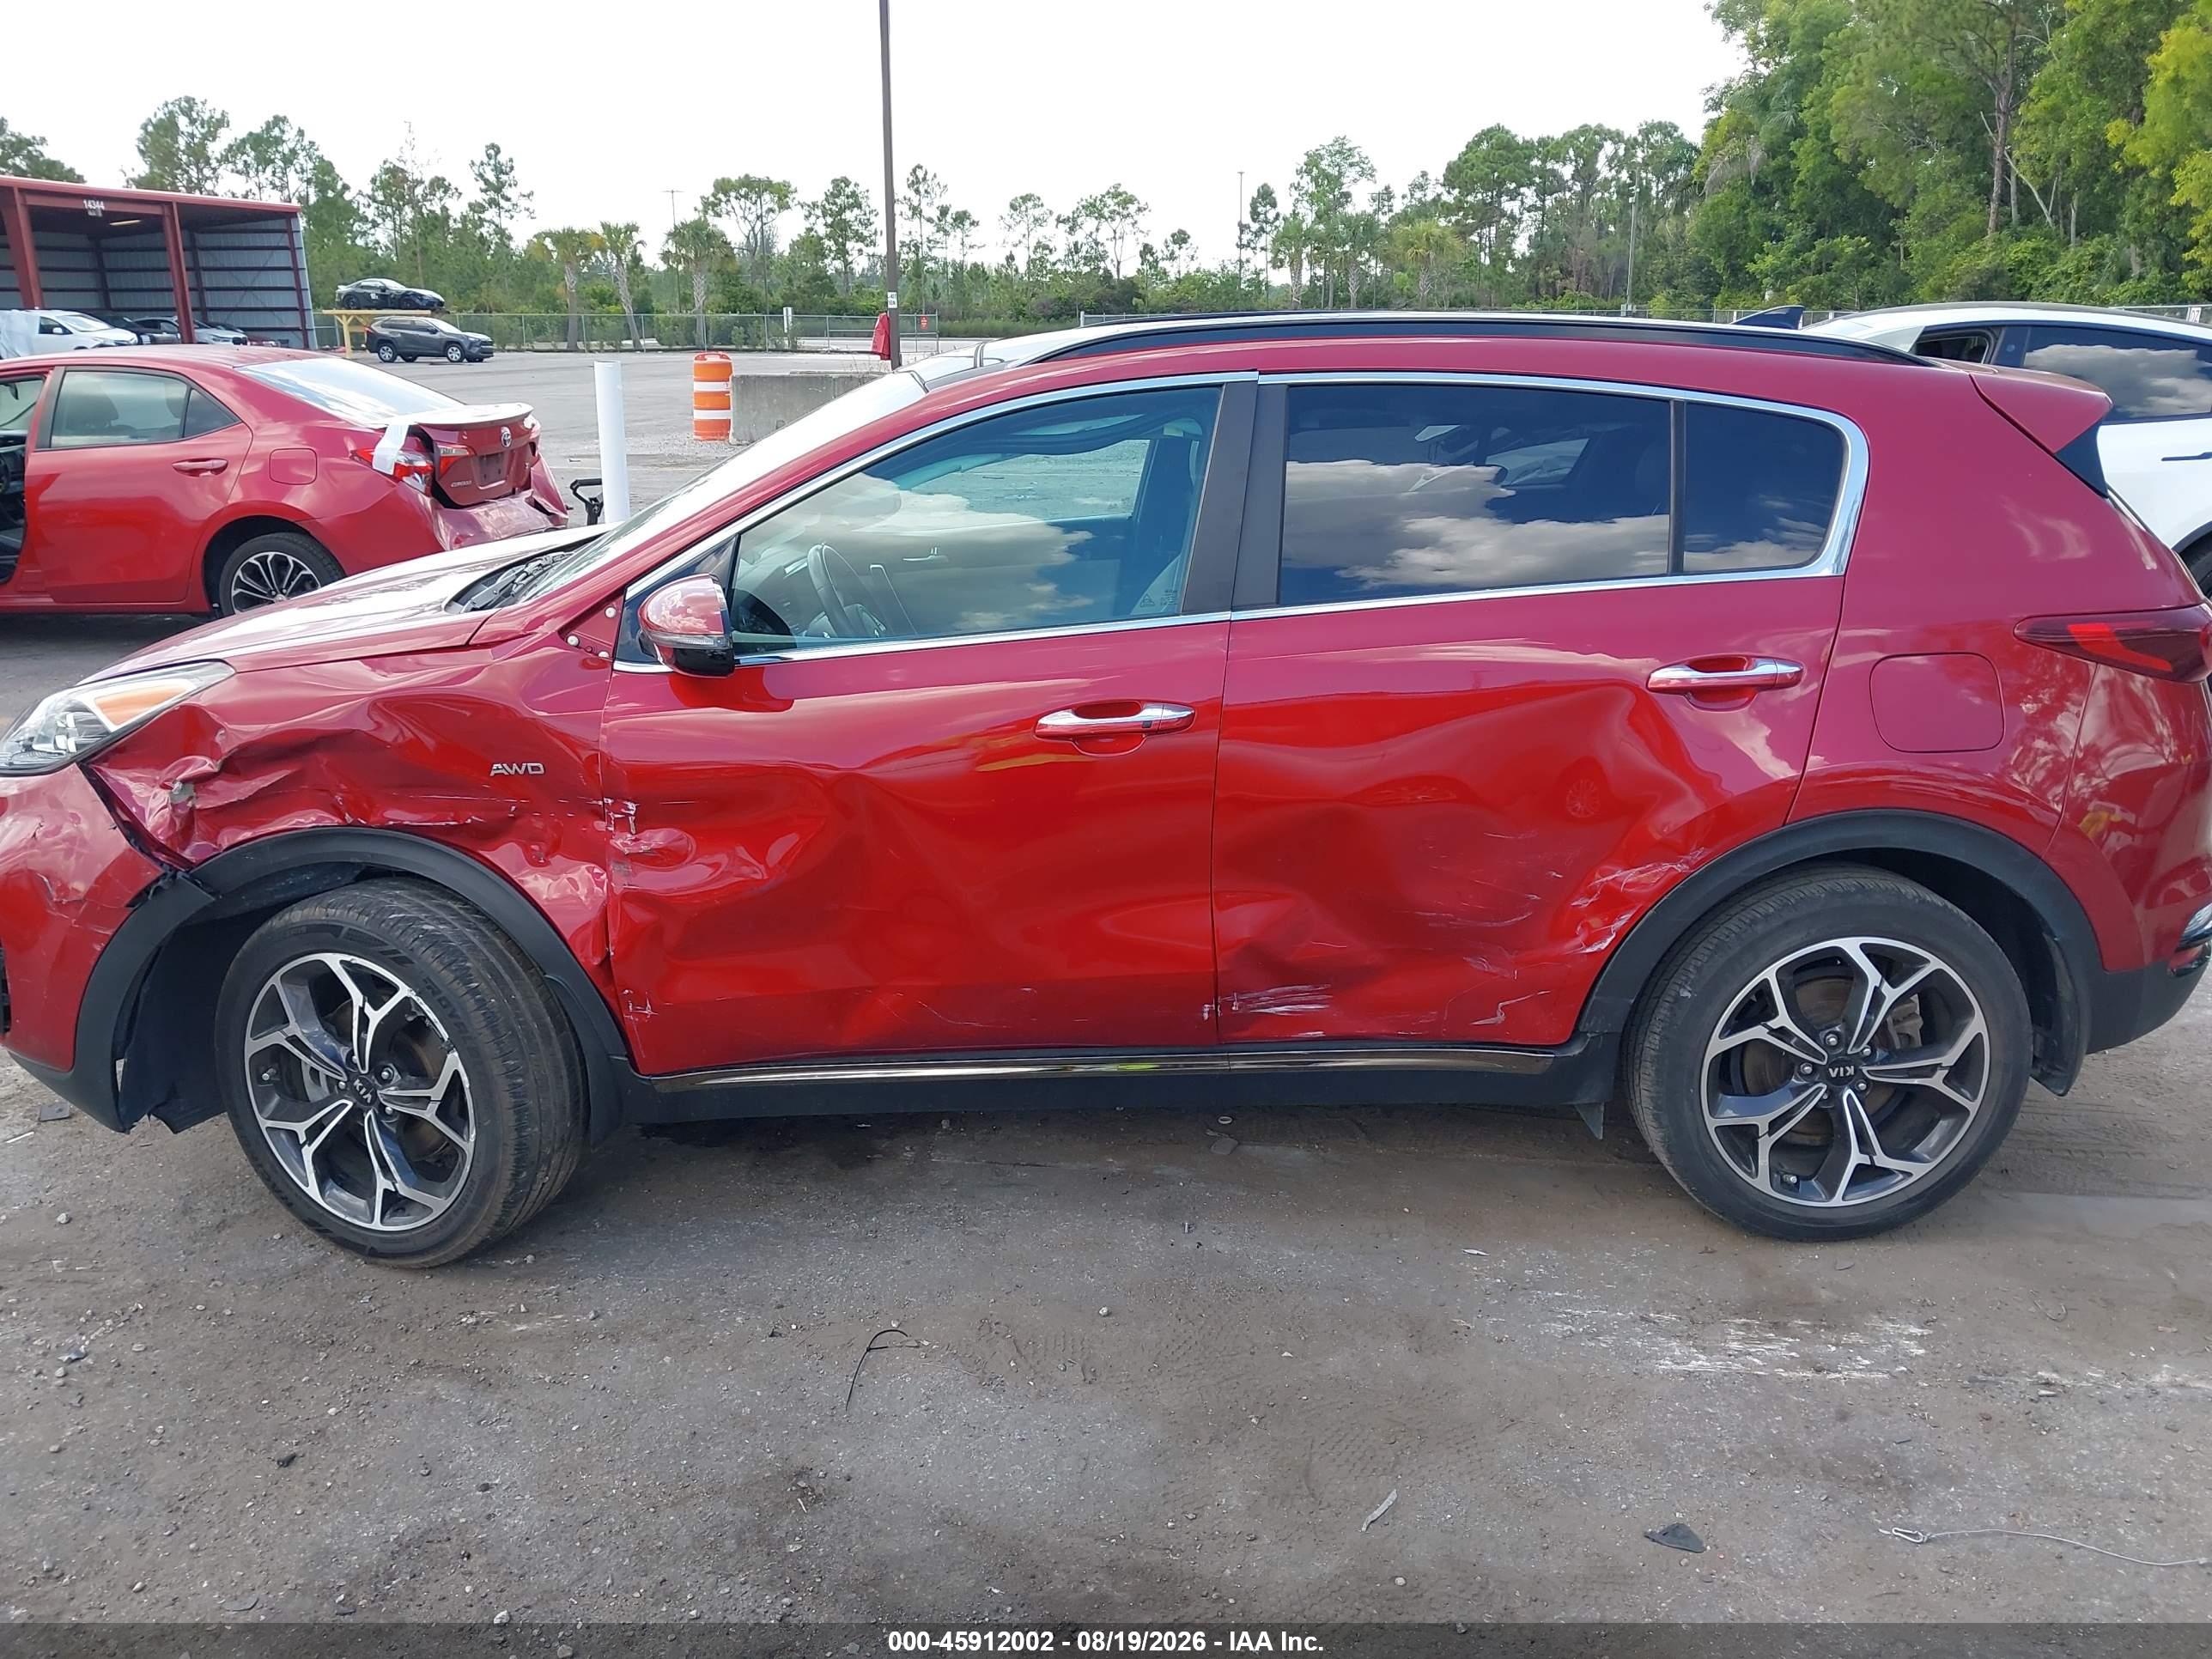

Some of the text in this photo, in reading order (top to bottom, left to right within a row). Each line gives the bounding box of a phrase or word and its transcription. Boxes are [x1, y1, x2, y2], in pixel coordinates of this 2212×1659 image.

[489, 763, 544, 776] AWD
[1829, 1066, 1854, 1078] KIA
[354, 1079, 372, 1103] KIA
